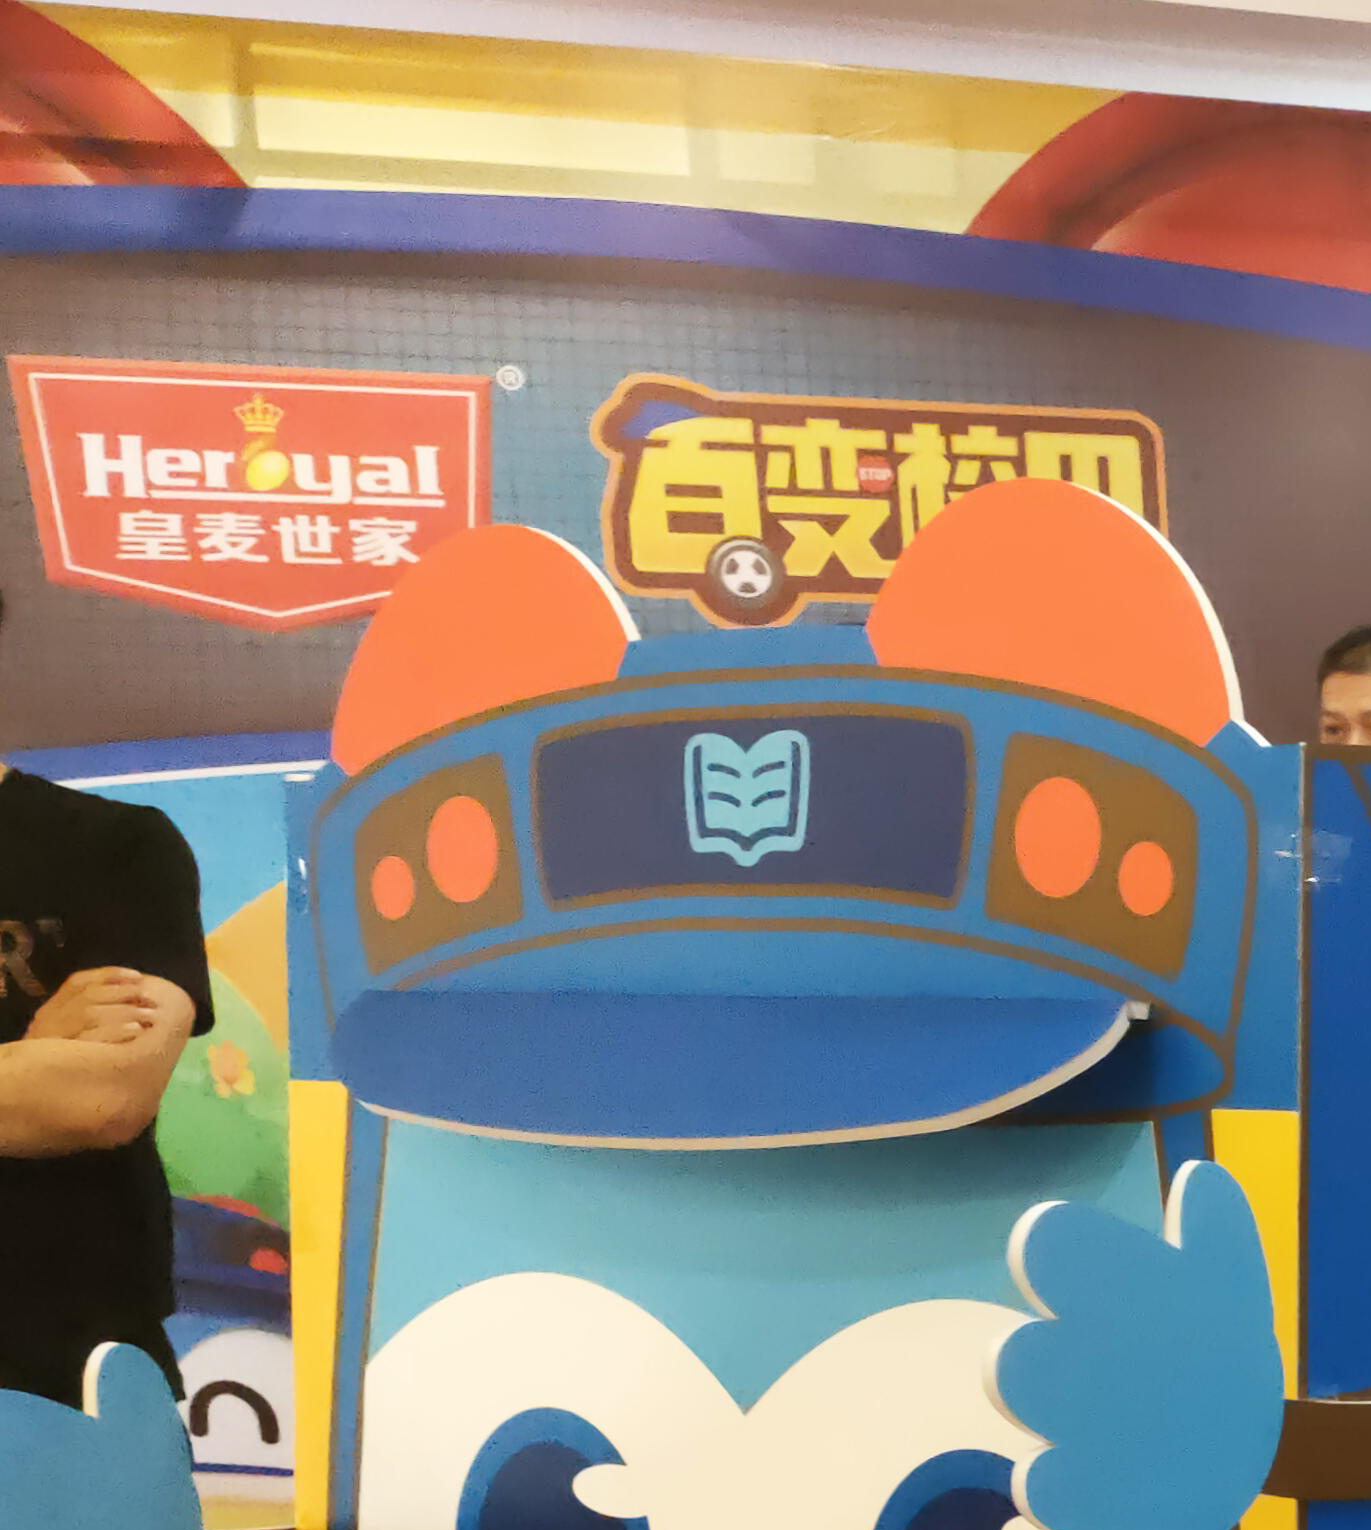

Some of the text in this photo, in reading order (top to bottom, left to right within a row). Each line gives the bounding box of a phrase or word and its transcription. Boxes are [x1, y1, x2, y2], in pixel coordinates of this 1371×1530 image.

[77, 431, 447, 509] Heroyal
[116, 508, 421, 566] 皇麦世家
